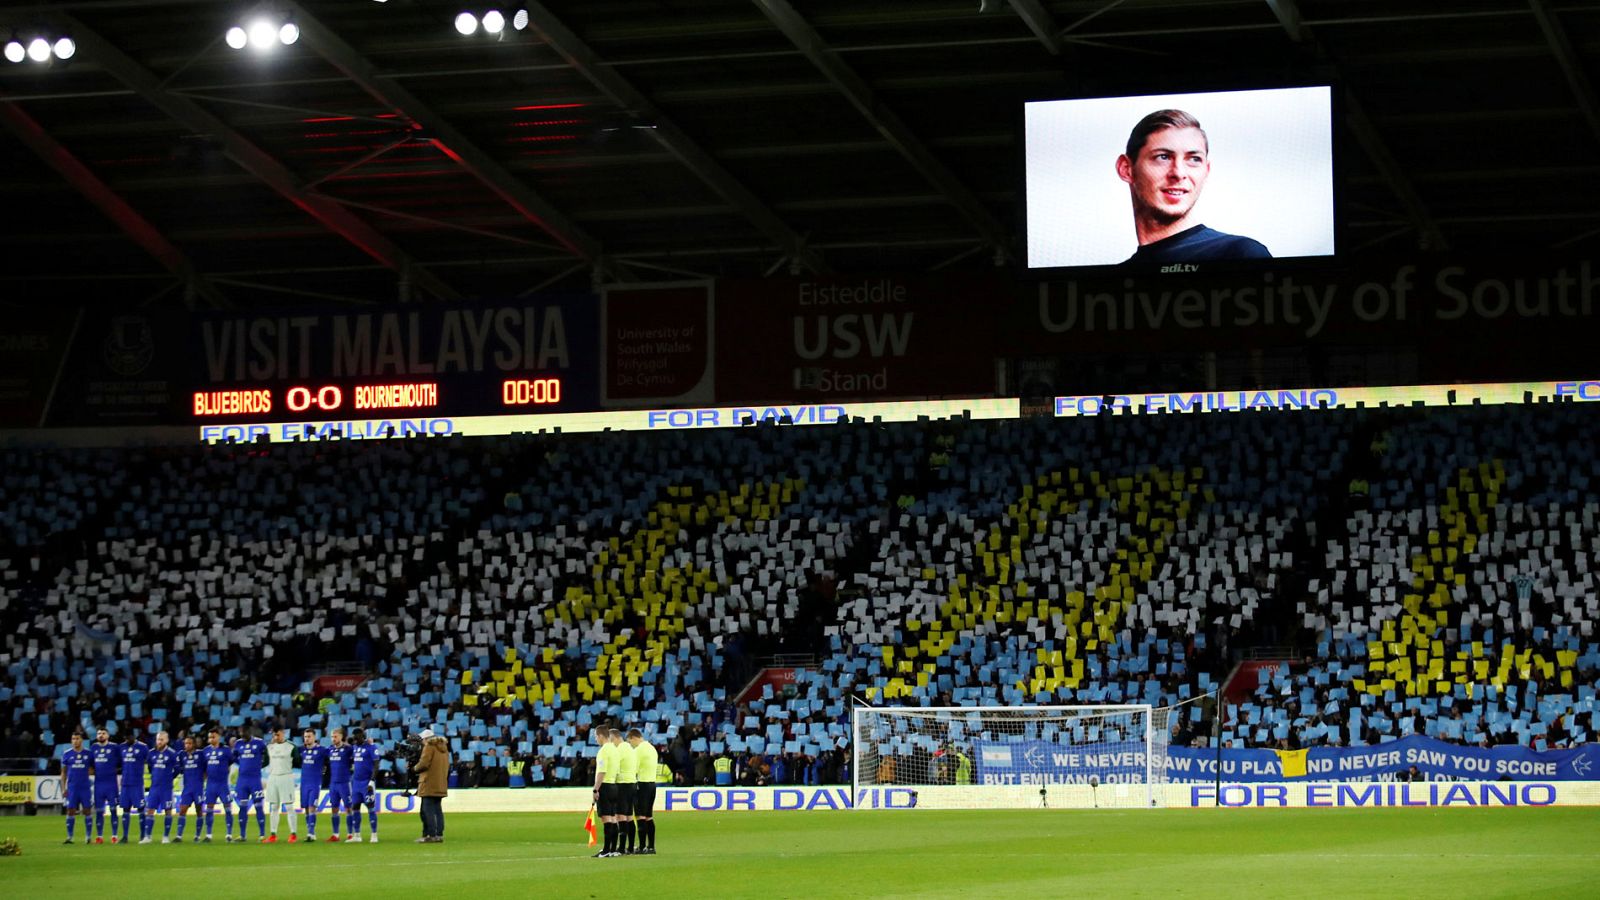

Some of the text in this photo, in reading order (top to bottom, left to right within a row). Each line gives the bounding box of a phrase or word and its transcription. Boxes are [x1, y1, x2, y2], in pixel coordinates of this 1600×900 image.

[1160, 263, 1200, 273] adi.tv
[798, 279, 907, 306] Eisteddle
[1039, 271, 1337, 338] University
[1352, 265, 1417, 322] of
[202, 304, 570, 382] VISIT MALAYSIA
[617, 325, 698, 343] University of
[793, 310, 914, 361] USW
[617, 340, 694, 355] South Wales
[617, 373, 634, 387] De
[818, 366, 888, 392] Stand
[194, 390, 271, 415] BLUEBIRDS
[287, 386, 342, 411] 0-0
[355, 384, 437, 409] BOURNEMOUTH
[502, 379, 560, 405] 00:00
[1145, 389, 1338, 413] EMILIANO
[648, 405, 847, 428] FOR DAVID
[203, 418, 454, 443] FOR EMILIANO
[1053, 753, 1079, 767] WE
[1085, 752, 1146, 768] NEVER
[1152, 755, 1191, 771] SAW
[1197, 759, 1236, 774] YOU
[1307, 760, 1334, 774] ND
[1339, 750, 1401, 771] NEVER
[1406, 748, 1446, 766] SAW
[1451, 755, 1490, 772] YOU
[1495, 759, 1556, 776] SCORE
[983, 773, 1016, 785] BUT
[1106, 773, 1142, 784] OUR
[665, 788, 917, 811] FOR DAVID
[1191, 783, 1557, 807] FOR EMILIANO
